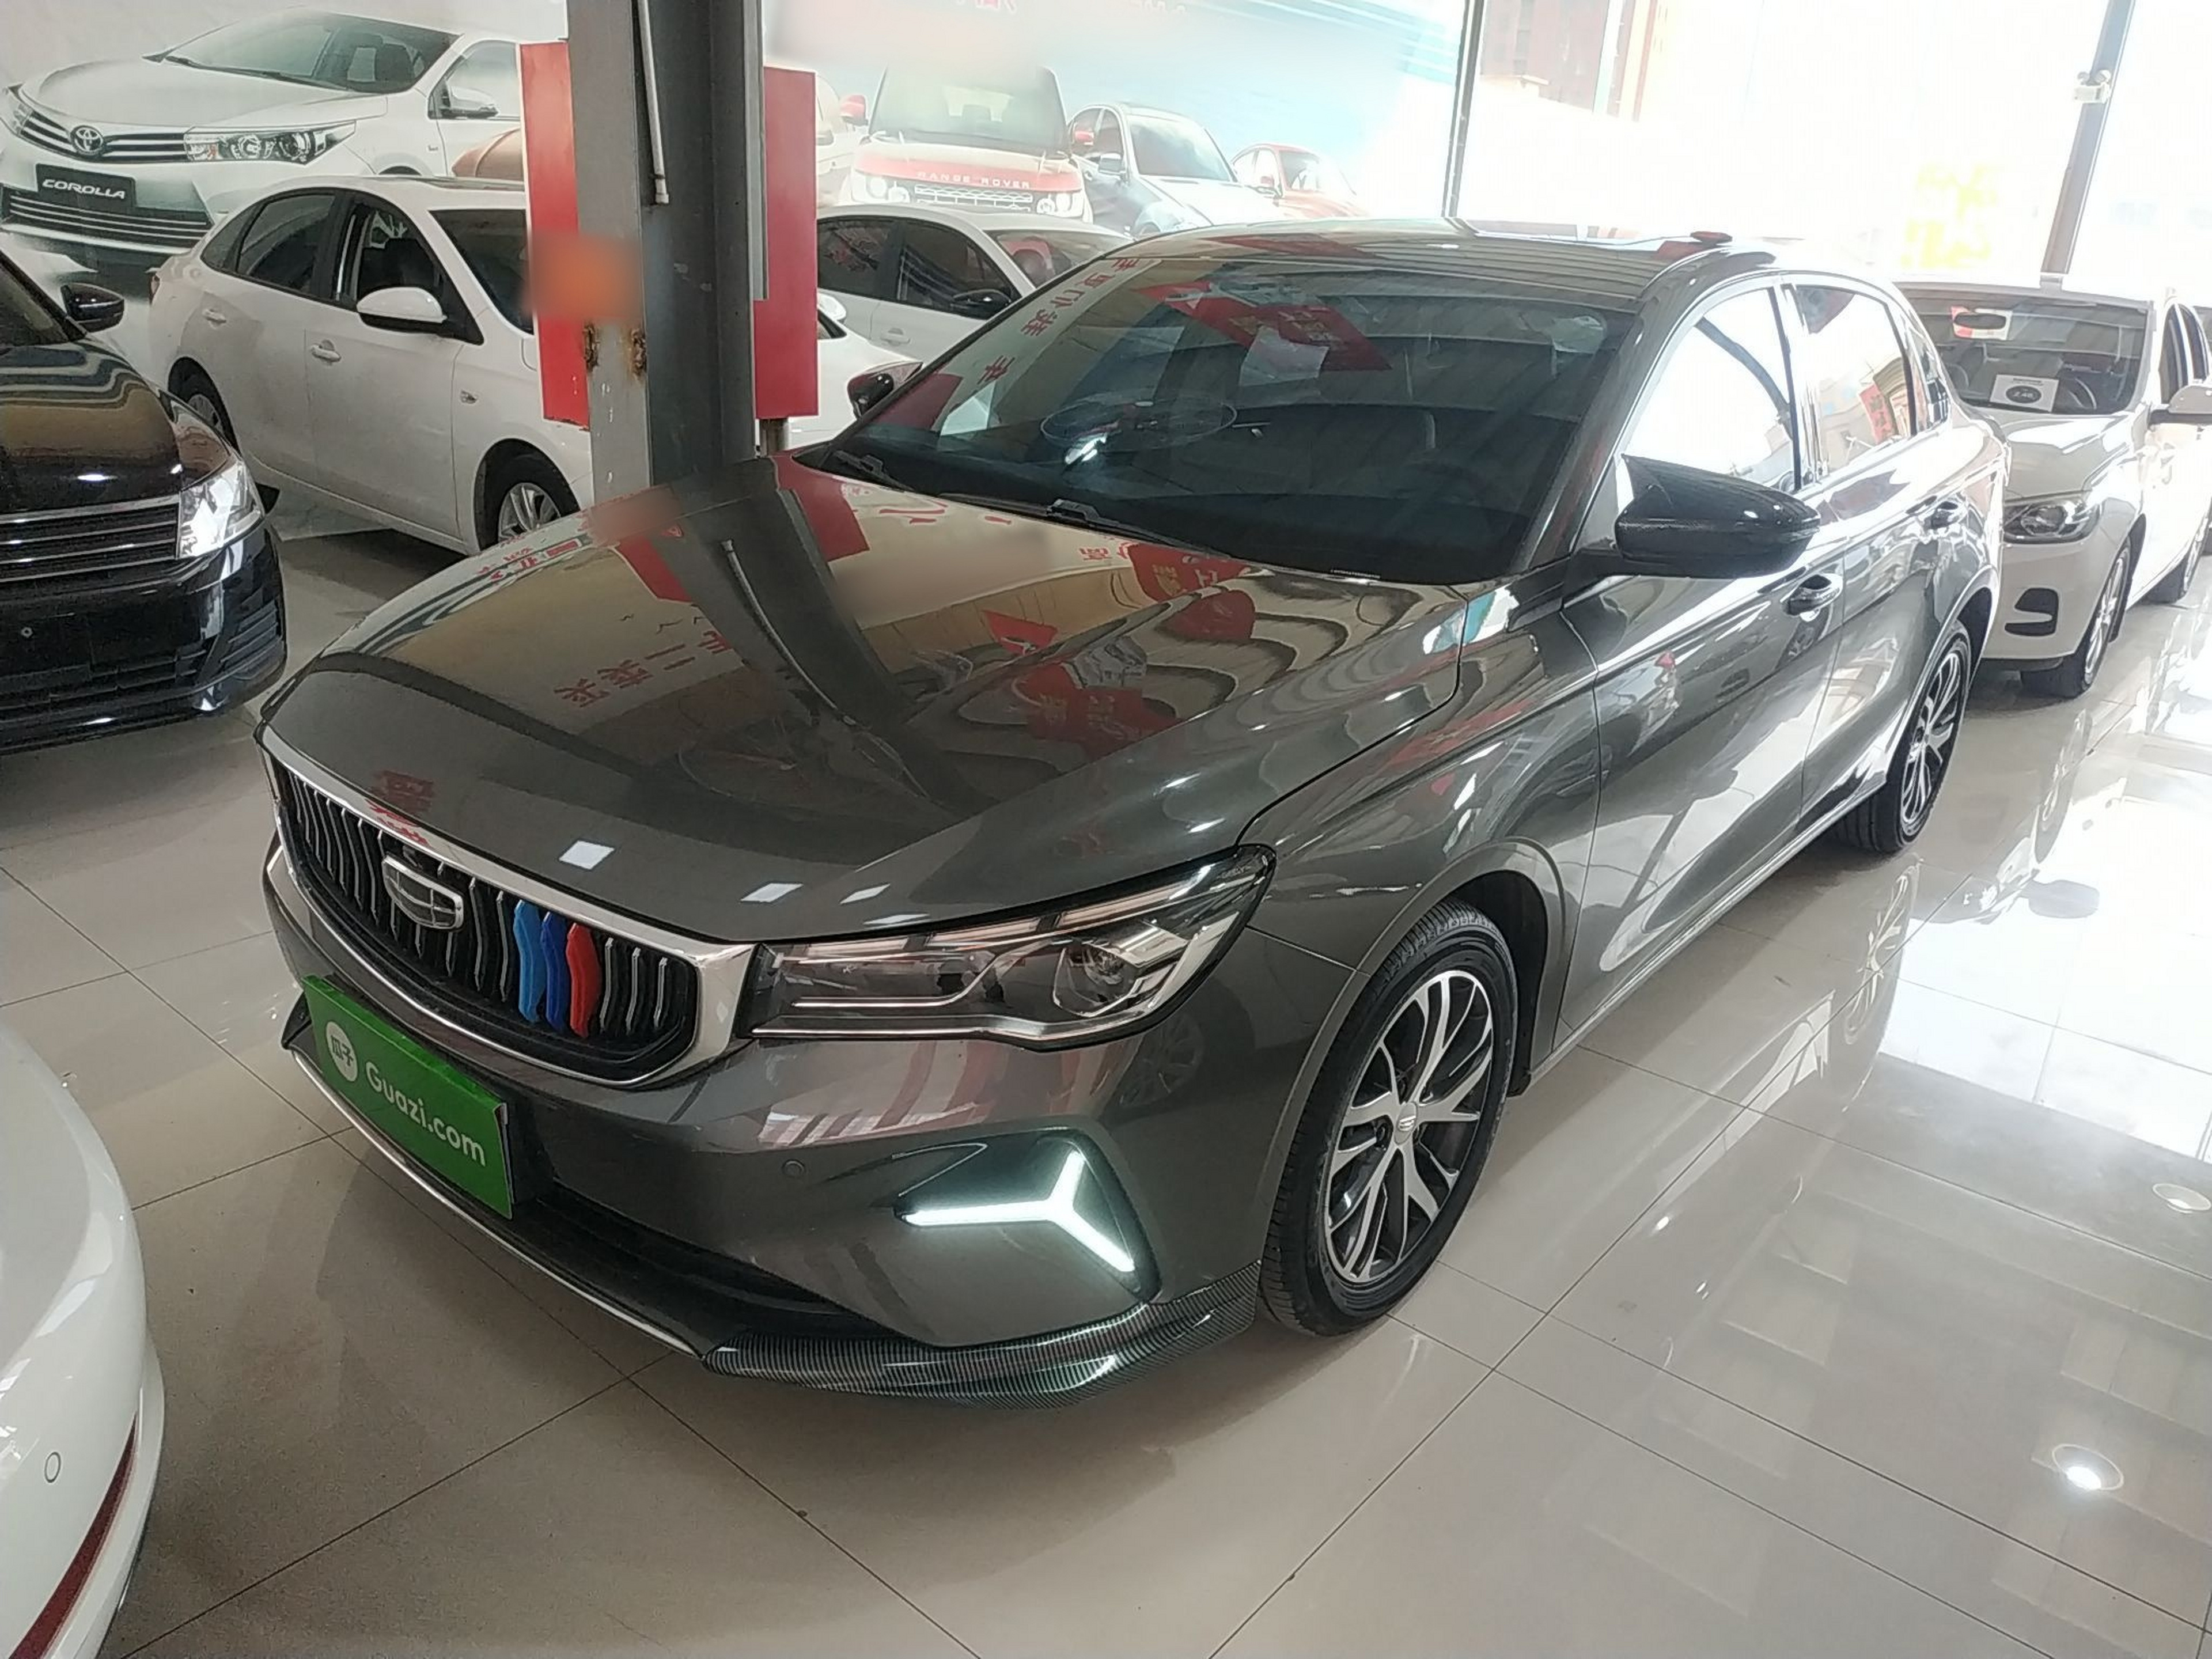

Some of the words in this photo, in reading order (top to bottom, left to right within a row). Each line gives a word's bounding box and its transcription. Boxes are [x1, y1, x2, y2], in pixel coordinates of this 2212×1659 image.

[42, 179, 126, 199] COROLLA
[917, 171, 972, 184] RANGE
[980, 177, 1031, 189] ROVER
[365, 1060, 486, 1167] Guazi.com
